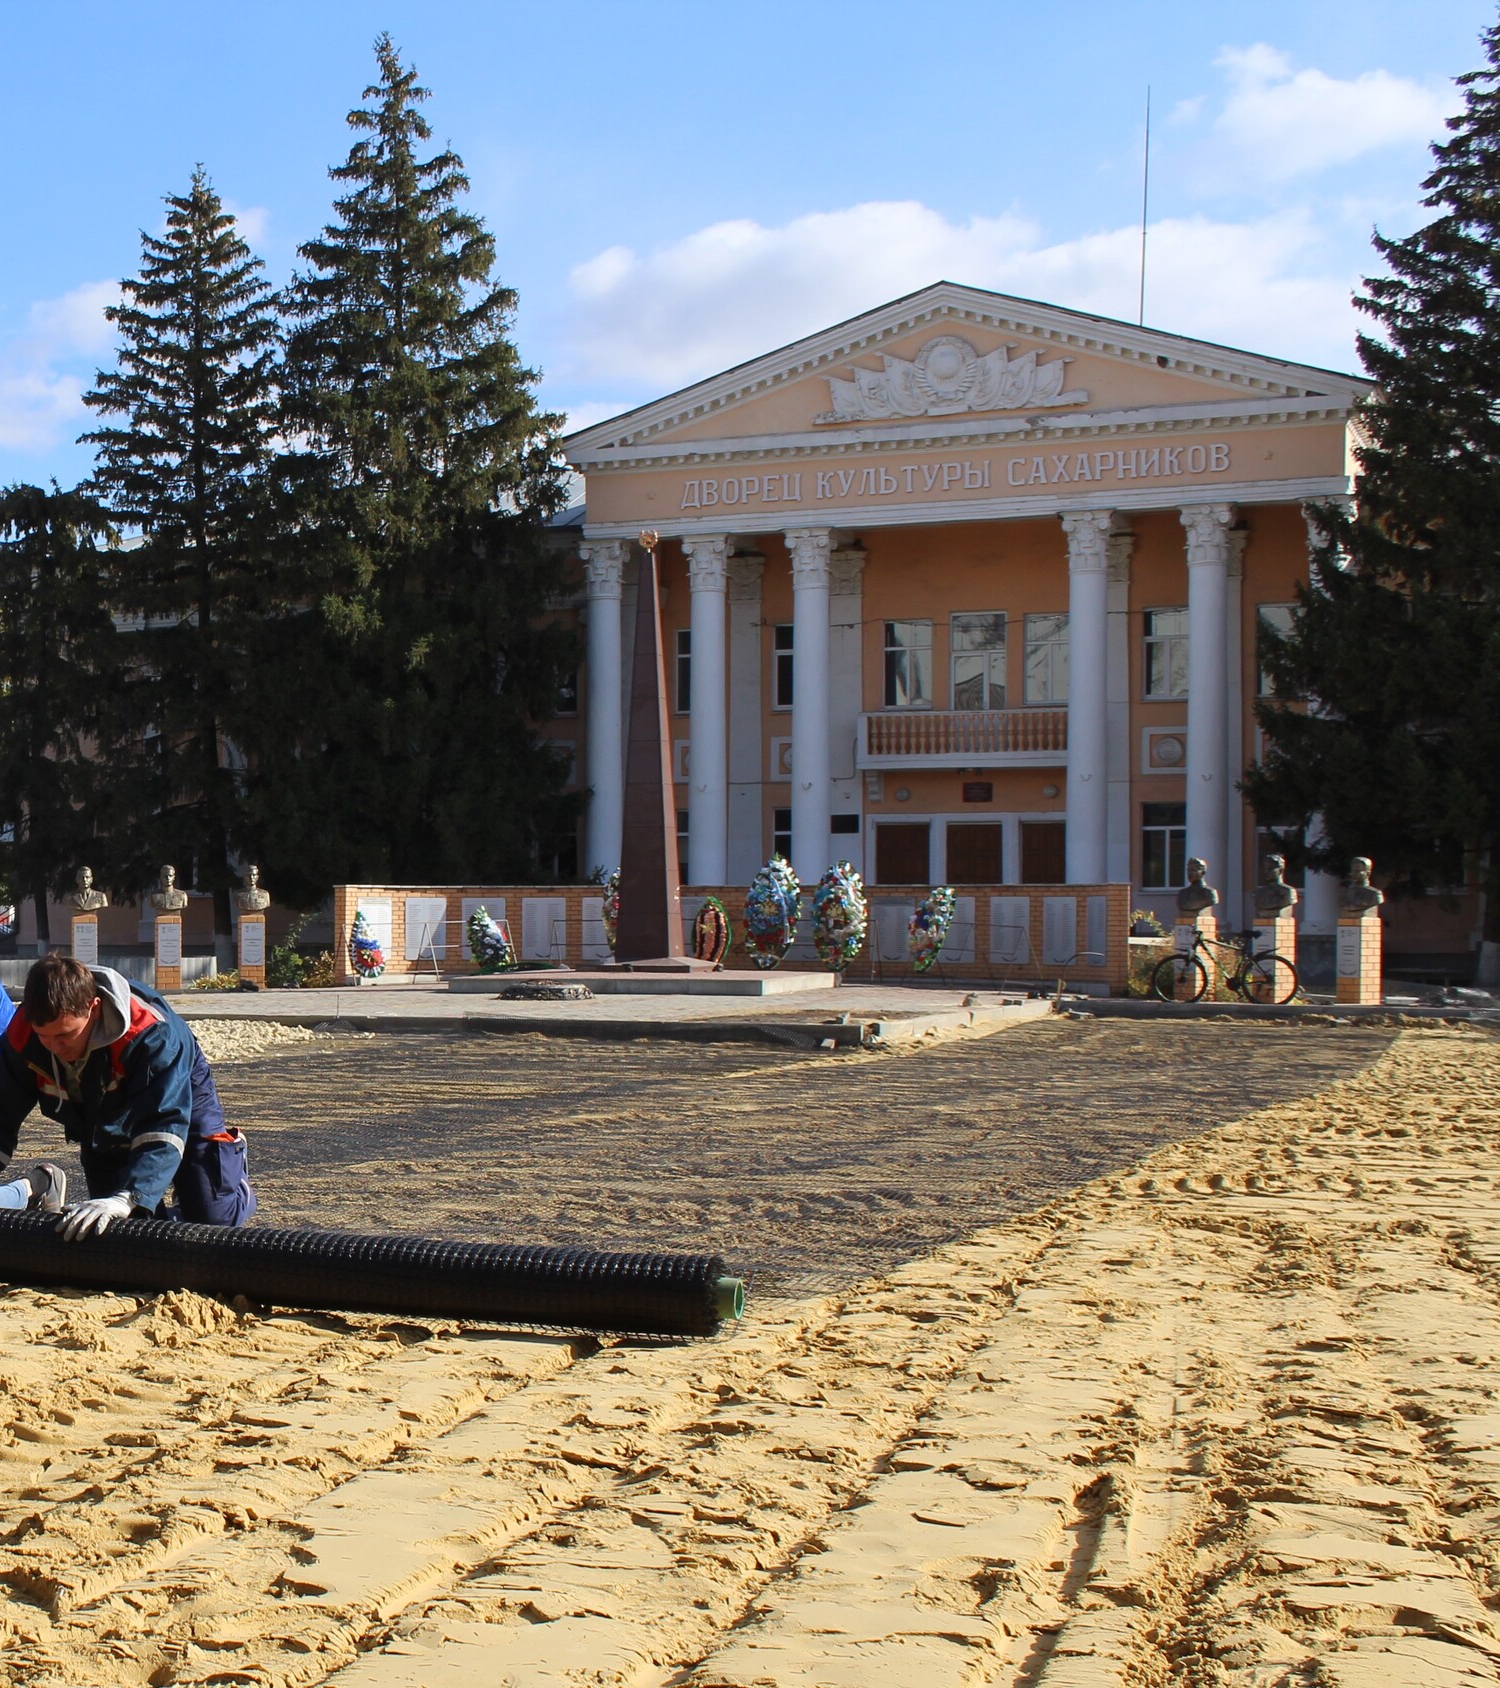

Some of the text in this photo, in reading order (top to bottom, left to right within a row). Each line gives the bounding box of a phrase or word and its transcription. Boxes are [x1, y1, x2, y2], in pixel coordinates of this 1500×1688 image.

[680, 442, 1232, 510] ДВОРЕЦ КУЛЬТУРЫ САХАРНИКОВ
